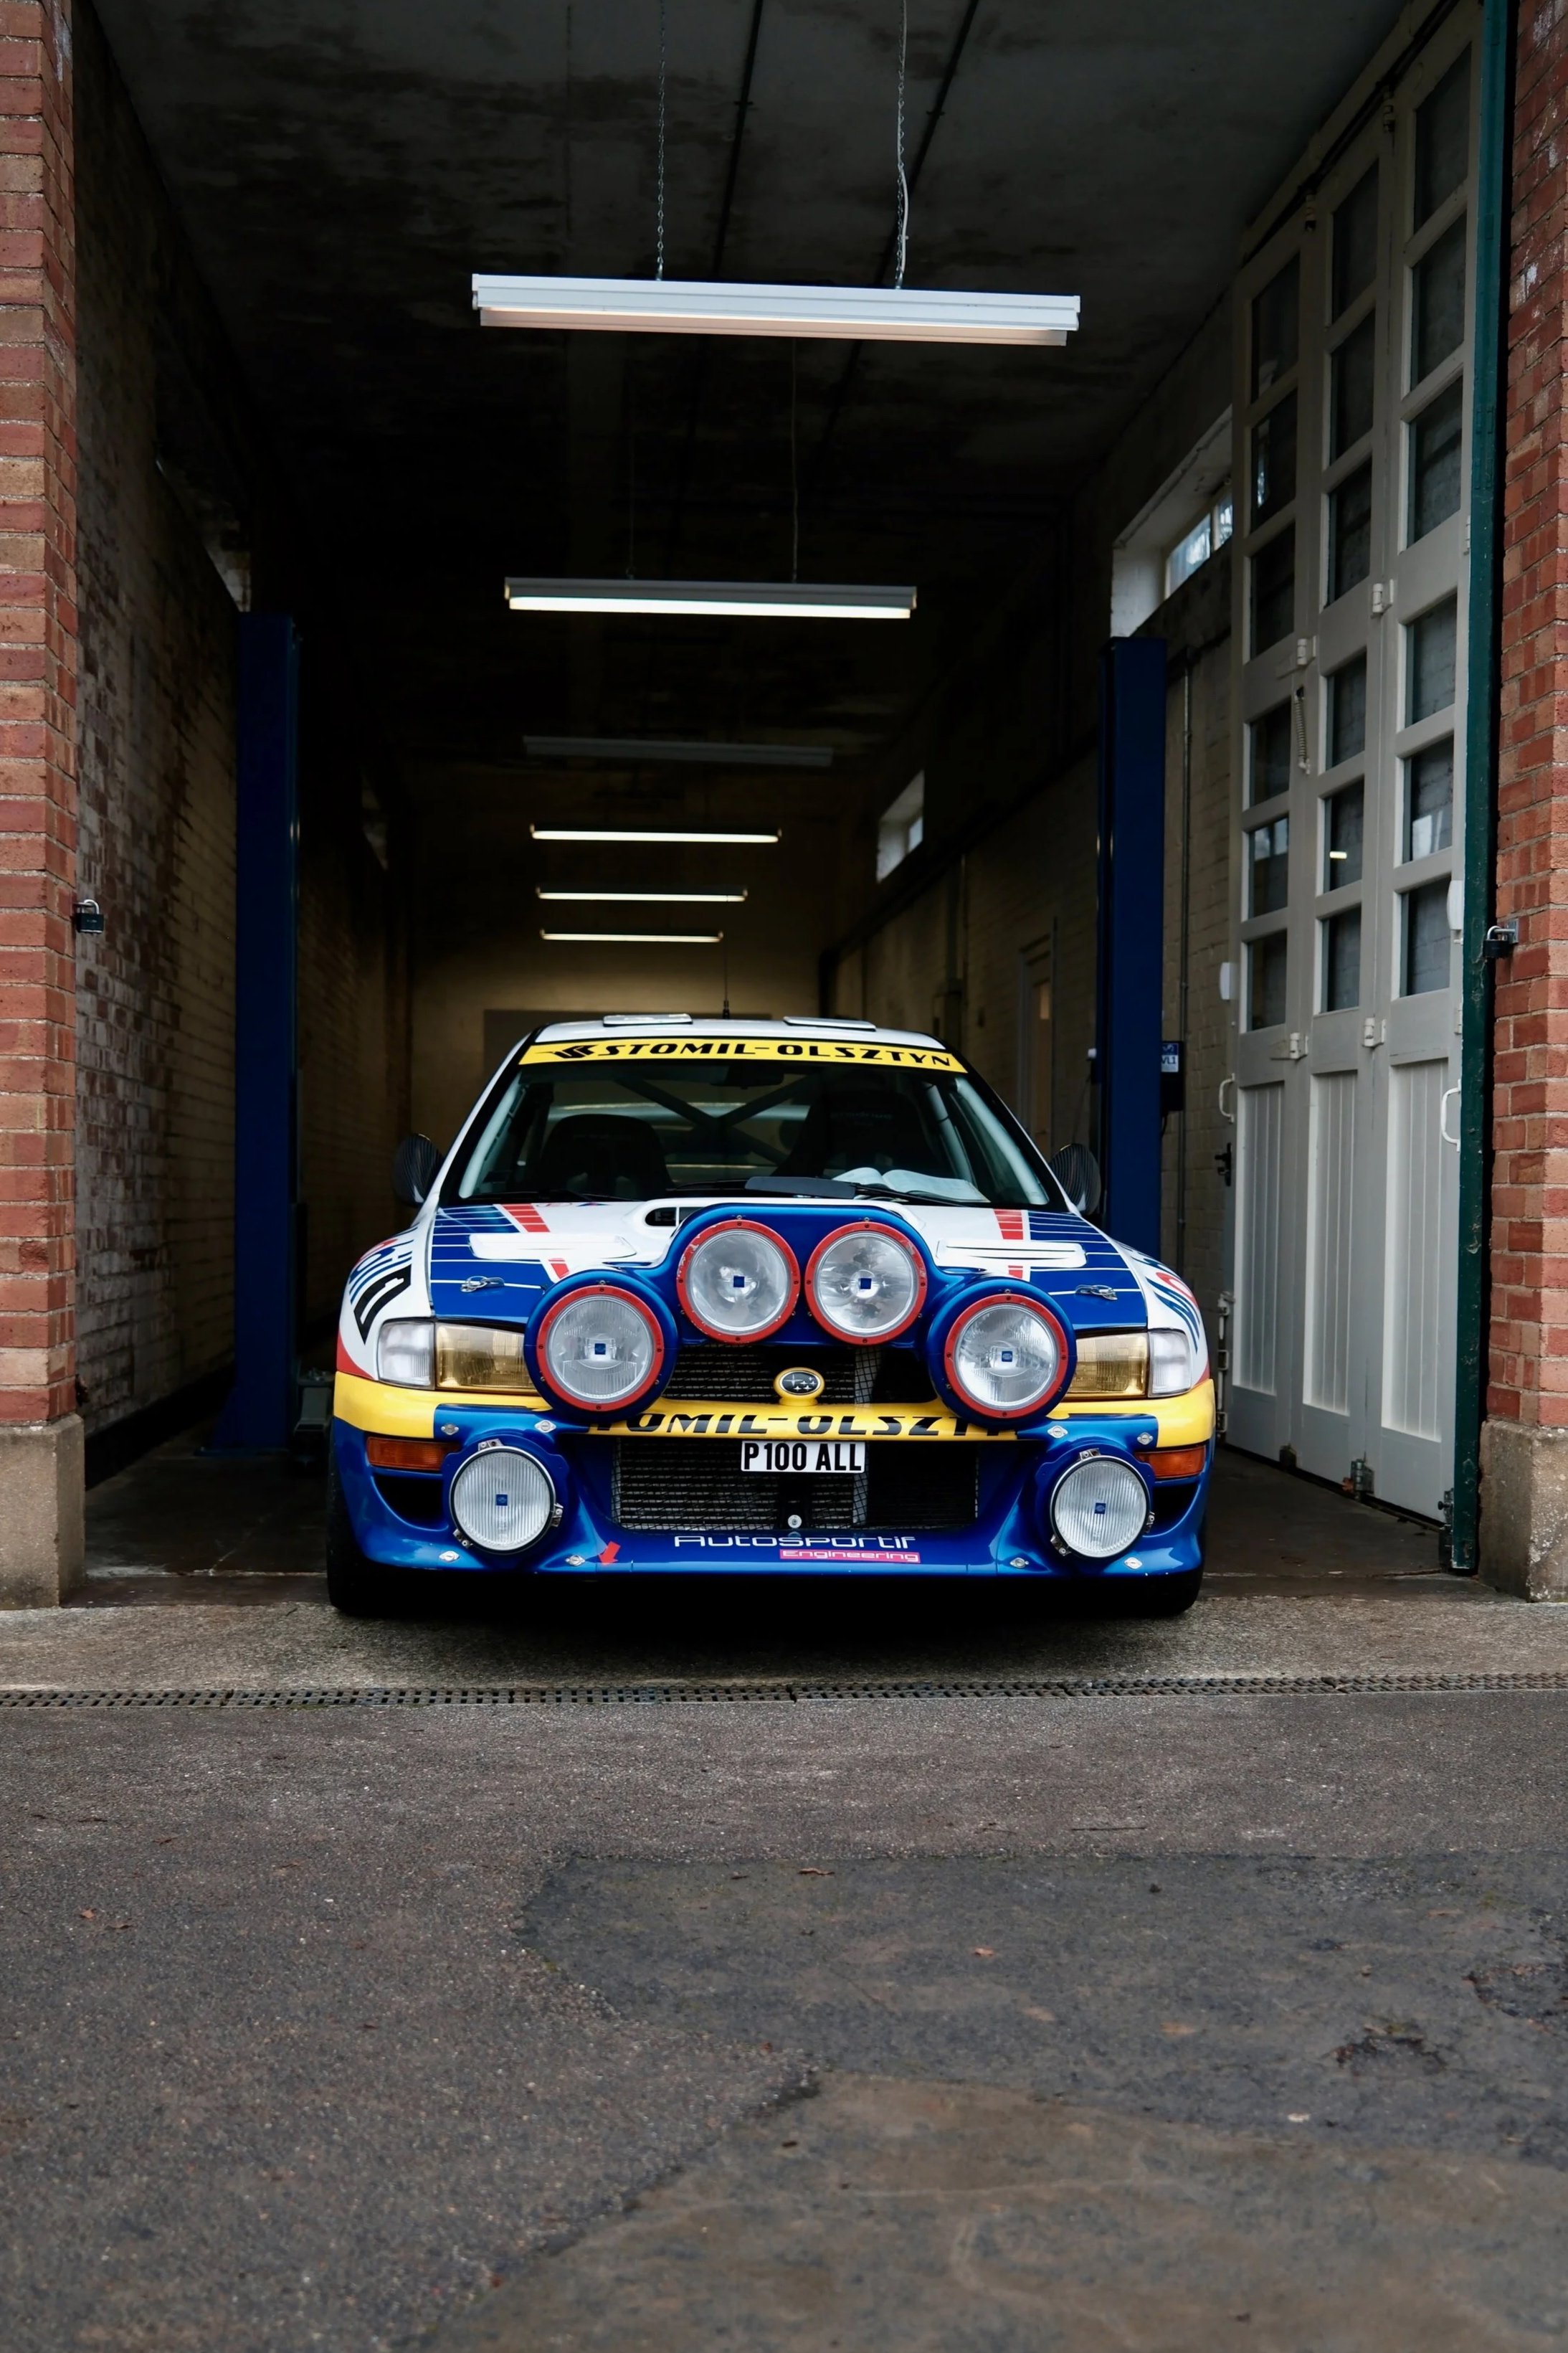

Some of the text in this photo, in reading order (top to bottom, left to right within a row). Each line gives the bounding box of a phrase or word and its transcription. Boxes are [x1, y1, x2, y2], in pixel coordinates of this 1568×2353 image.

[598, 1042, 951, 1066] STOMIL-OLSZTYN
[596, 1413, 1000, 1436] OMIL-OLSZT
[743, 1442, 862, 1471] P100 ALL
[674, 1535, 916, 1549] Autosportif
[782, 1550, 920, 1562] Engineering
